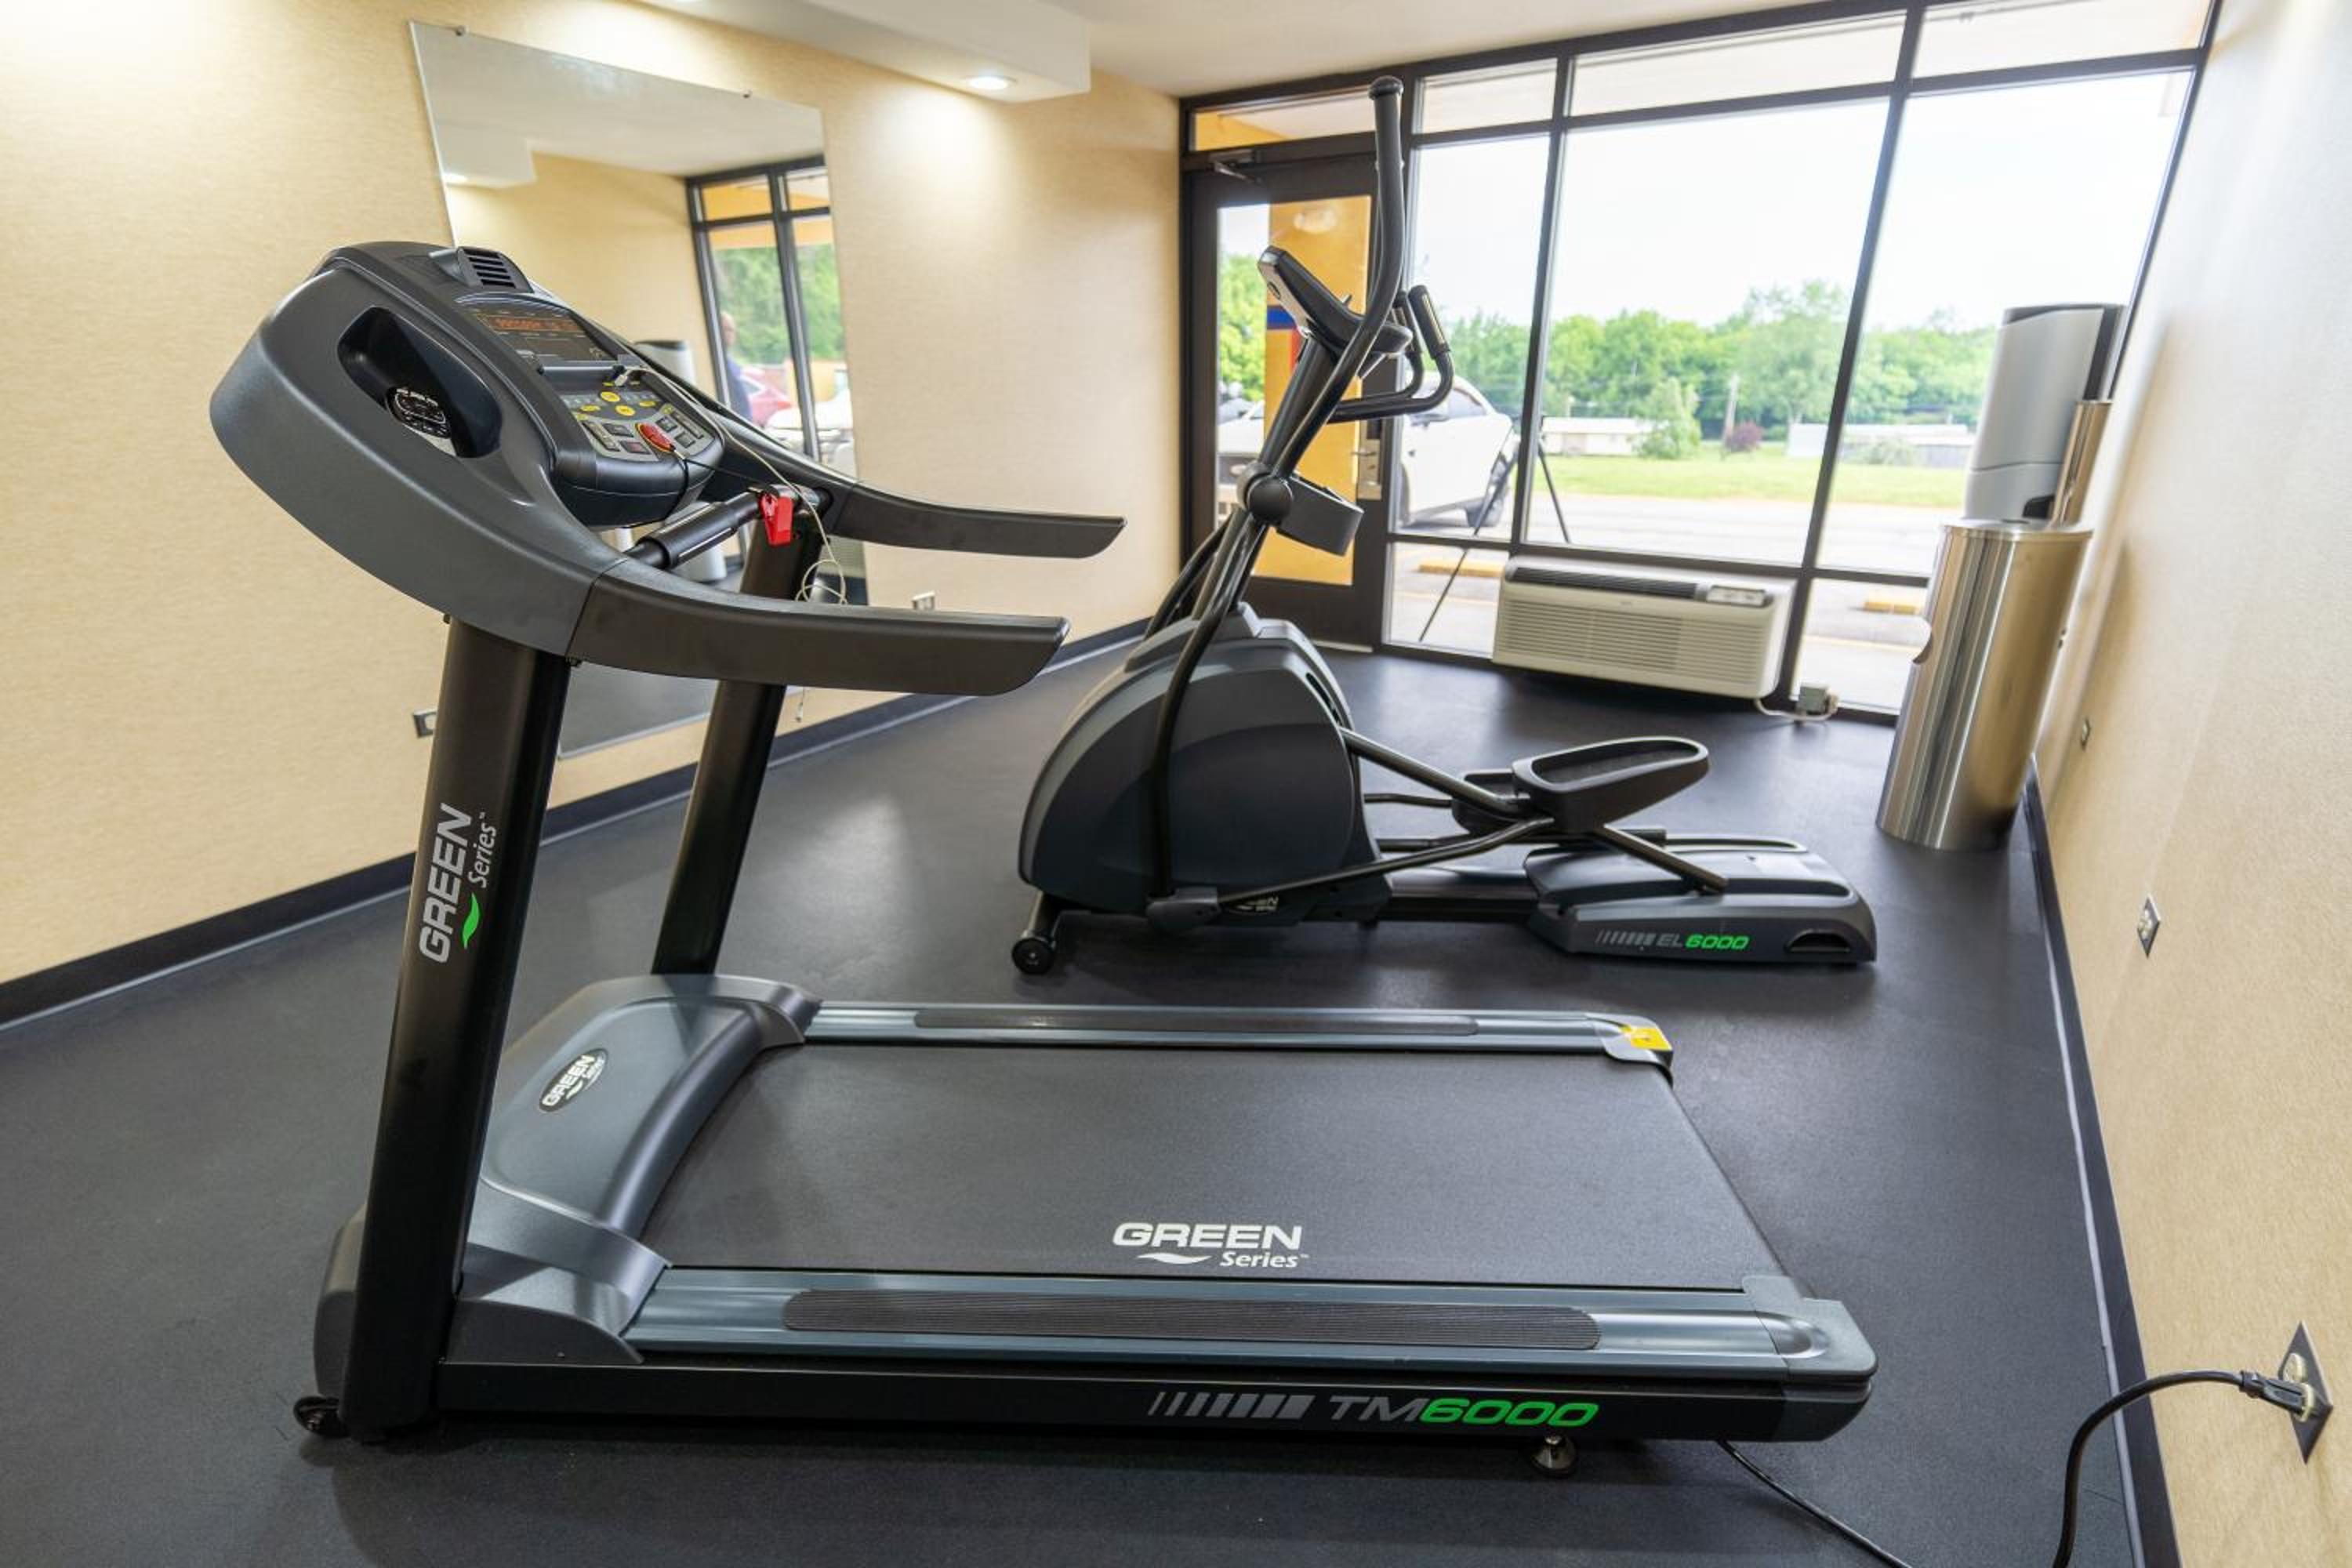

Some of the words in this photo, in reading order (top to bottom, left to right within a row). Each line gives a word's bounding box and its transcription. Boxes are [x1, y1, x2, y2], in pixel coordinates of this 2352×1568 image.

[468, 821, 497, 889] Series
[419, 802, 473, 964] GREEN
[1656, 933, 1750, 951] EL6000
[542, 1054, 595, 1106] GREEN
[1112, 1222, 1302, 1250] GREEN
[1219, 1250, 1299, 1268] Series
[1329, 1395, 1599, 1427] TM6000
